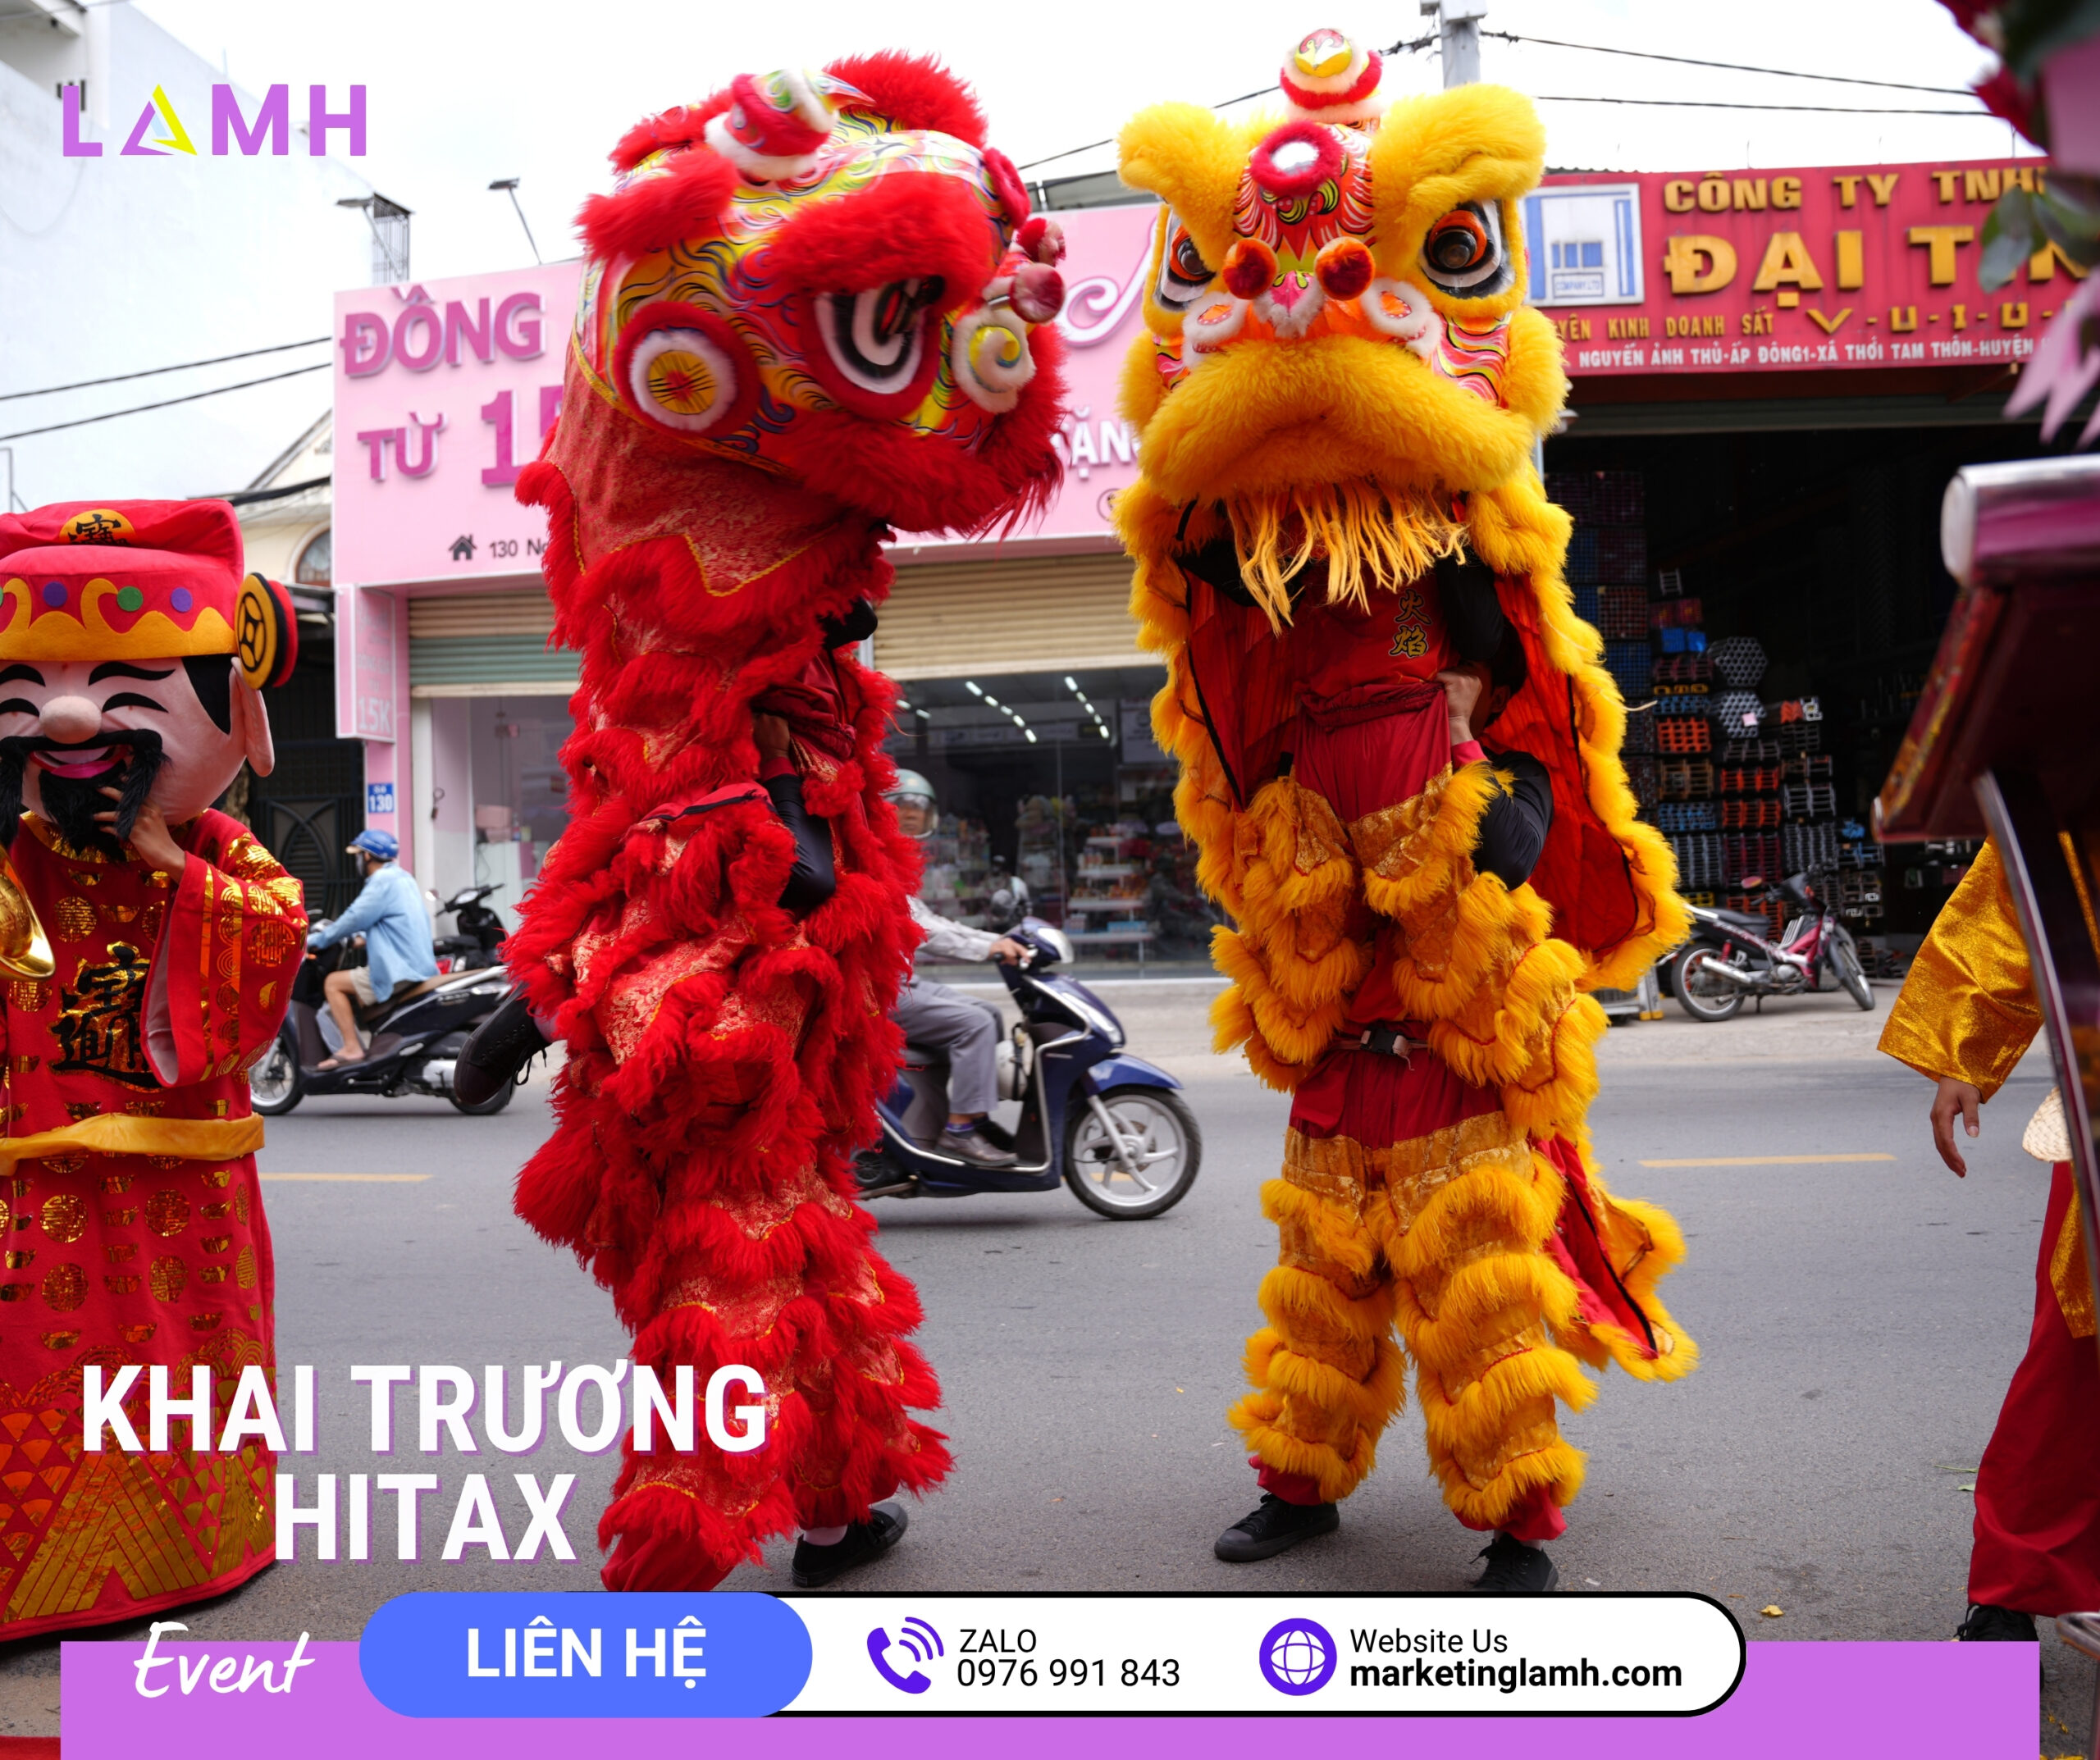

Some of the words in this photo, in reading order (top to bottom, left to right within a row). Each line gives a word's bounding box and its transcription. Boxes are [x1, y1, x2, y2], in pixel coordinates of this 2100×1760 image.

[1664, 171, 1801, 212] CÔNG
[1833, 173, 1900, 207] TY
[1664, 229, 1865, 308] ĐẠI
[340, 285, 544, 377] ĐỒNG
[1556, 313, 1591, 340] YÊN
[1608, 317, 1650, 339] KINH
[1665, 315, 1726, 337] DOANH
[1891, 341, 1924, 360] TAM
[357, 412, 446, 482] TỪ
[490, 540, 518, 558] 130
[358, 696, 391, 736] 15K
[369, 794, 393, 813] 130
